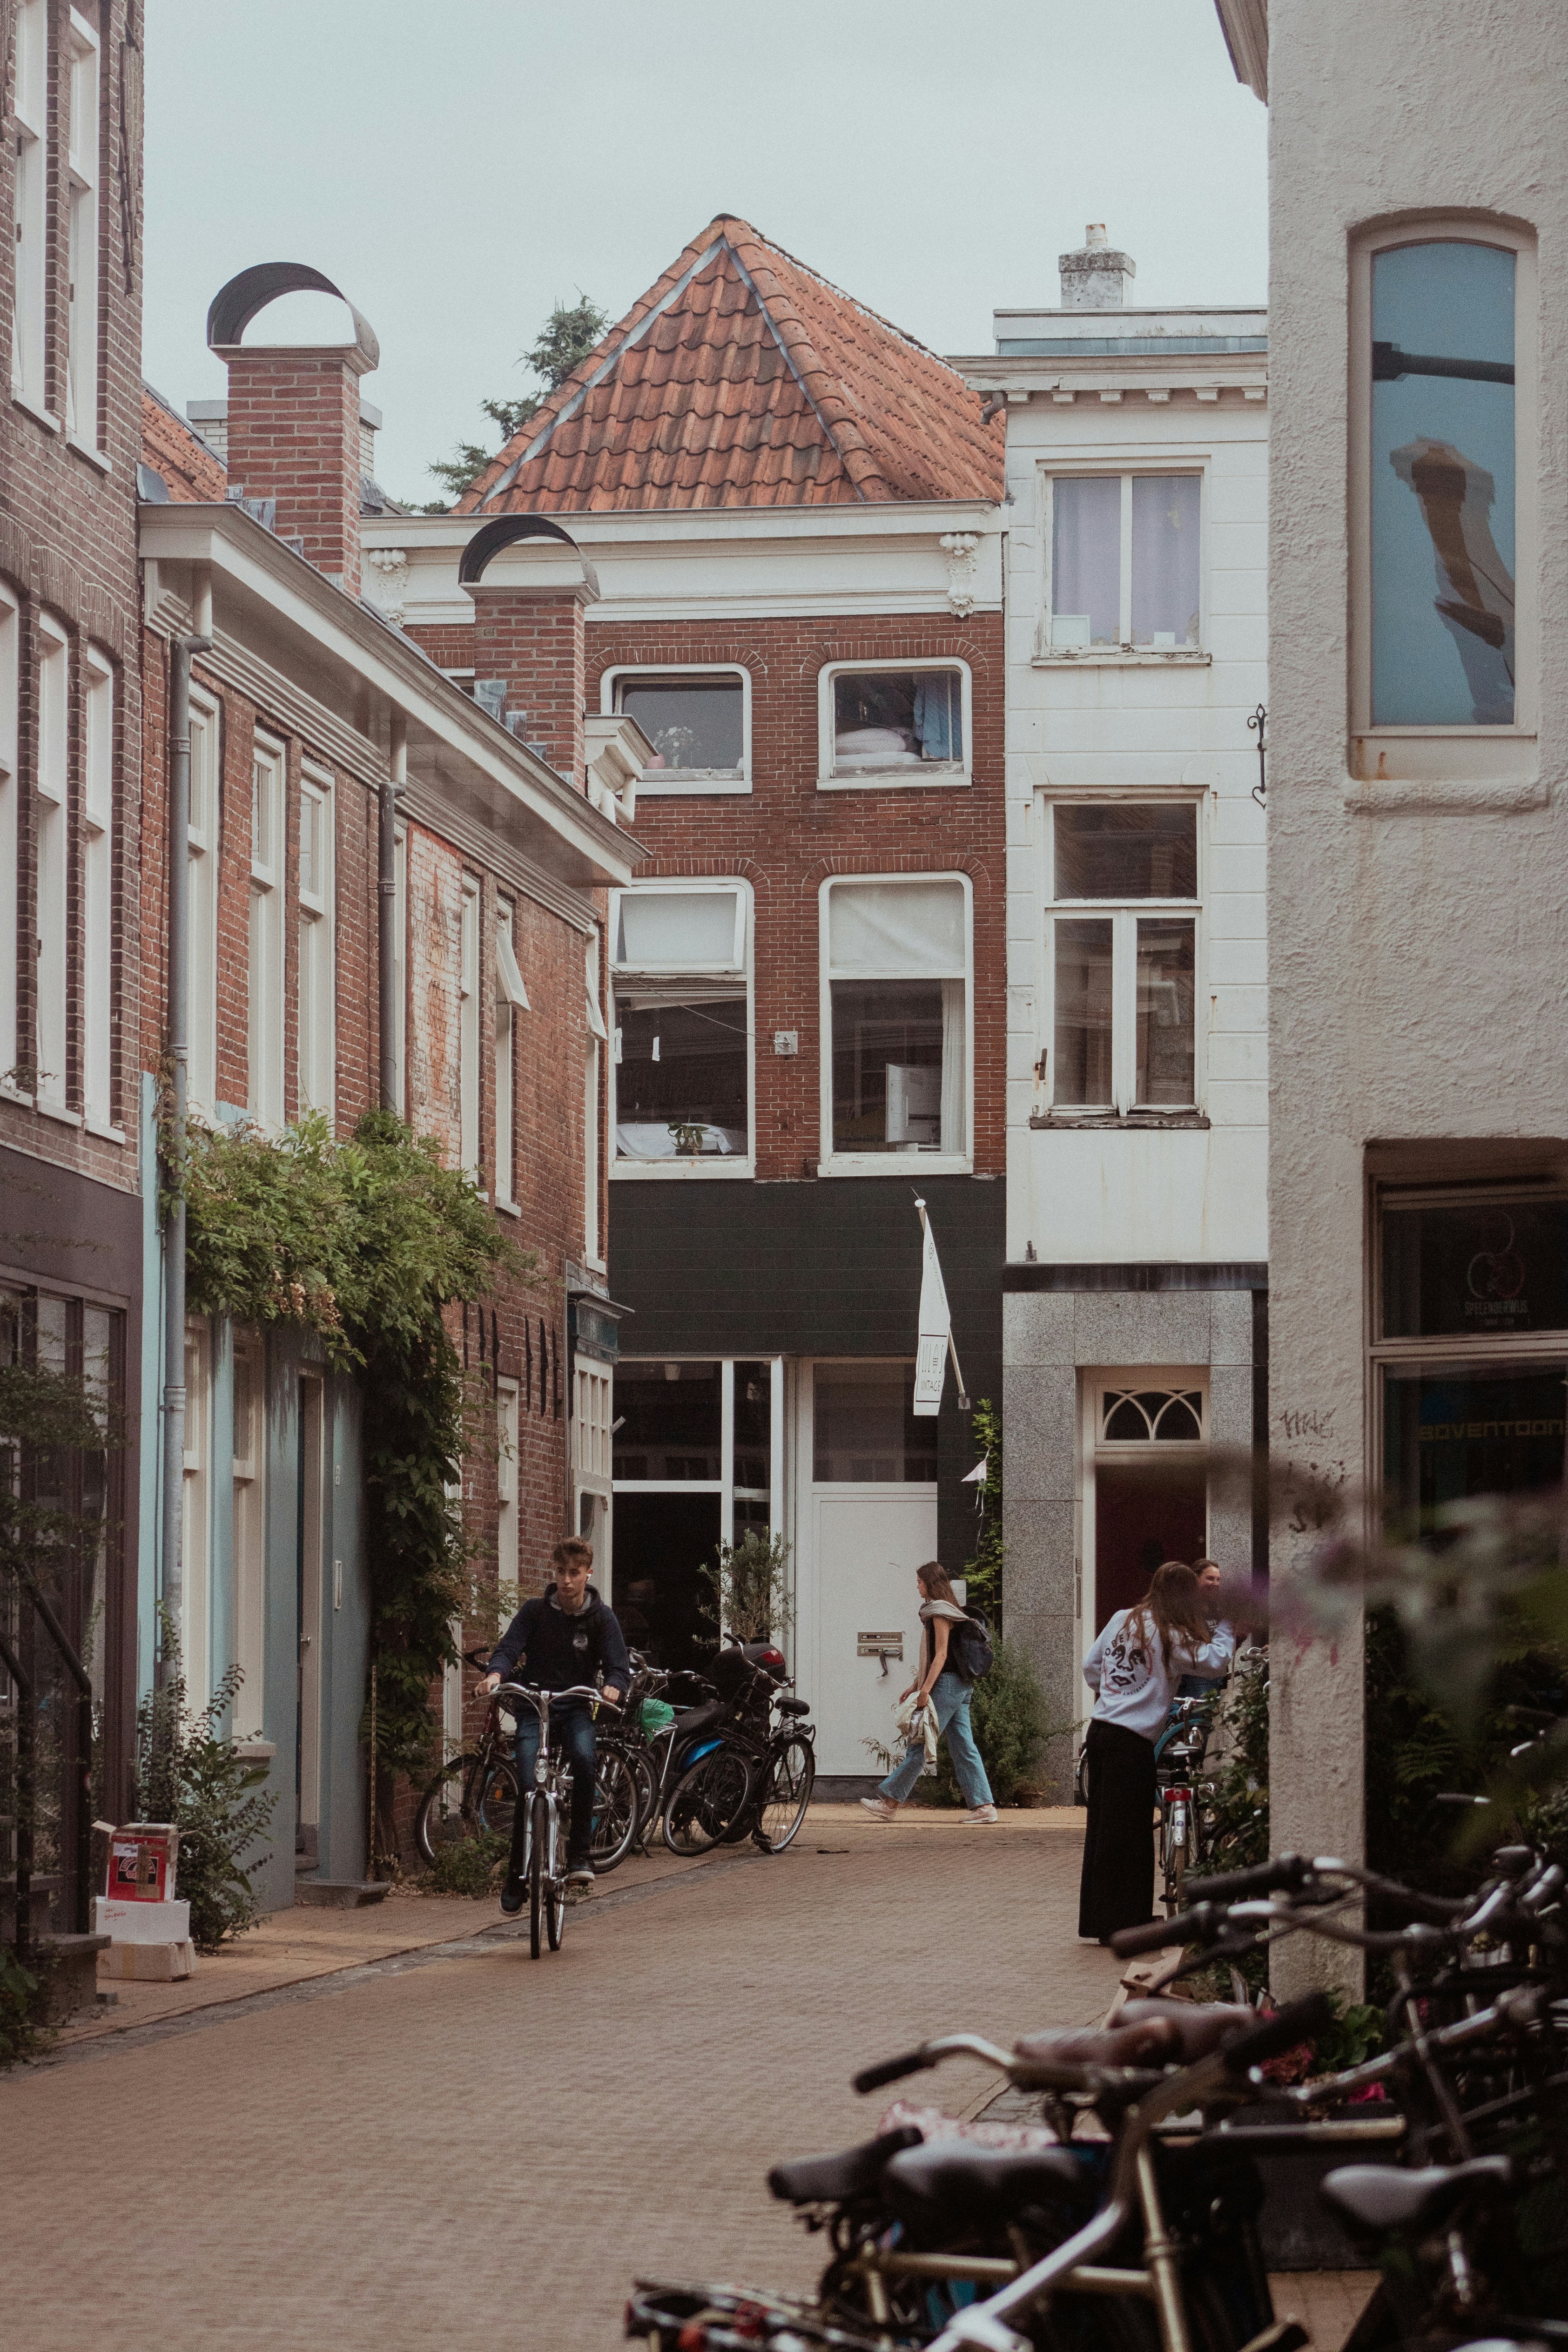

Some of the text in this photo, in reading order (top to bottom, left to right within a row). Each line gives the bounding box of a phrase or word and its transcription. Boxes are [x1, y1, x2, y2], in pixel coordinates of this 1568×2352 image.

[921, 1380, 941, 1391] VINTAGE
[1105, 1632, 1131, 1656] OBEY
[1123, 1677, 1150, 1696] AMSTERDAM
